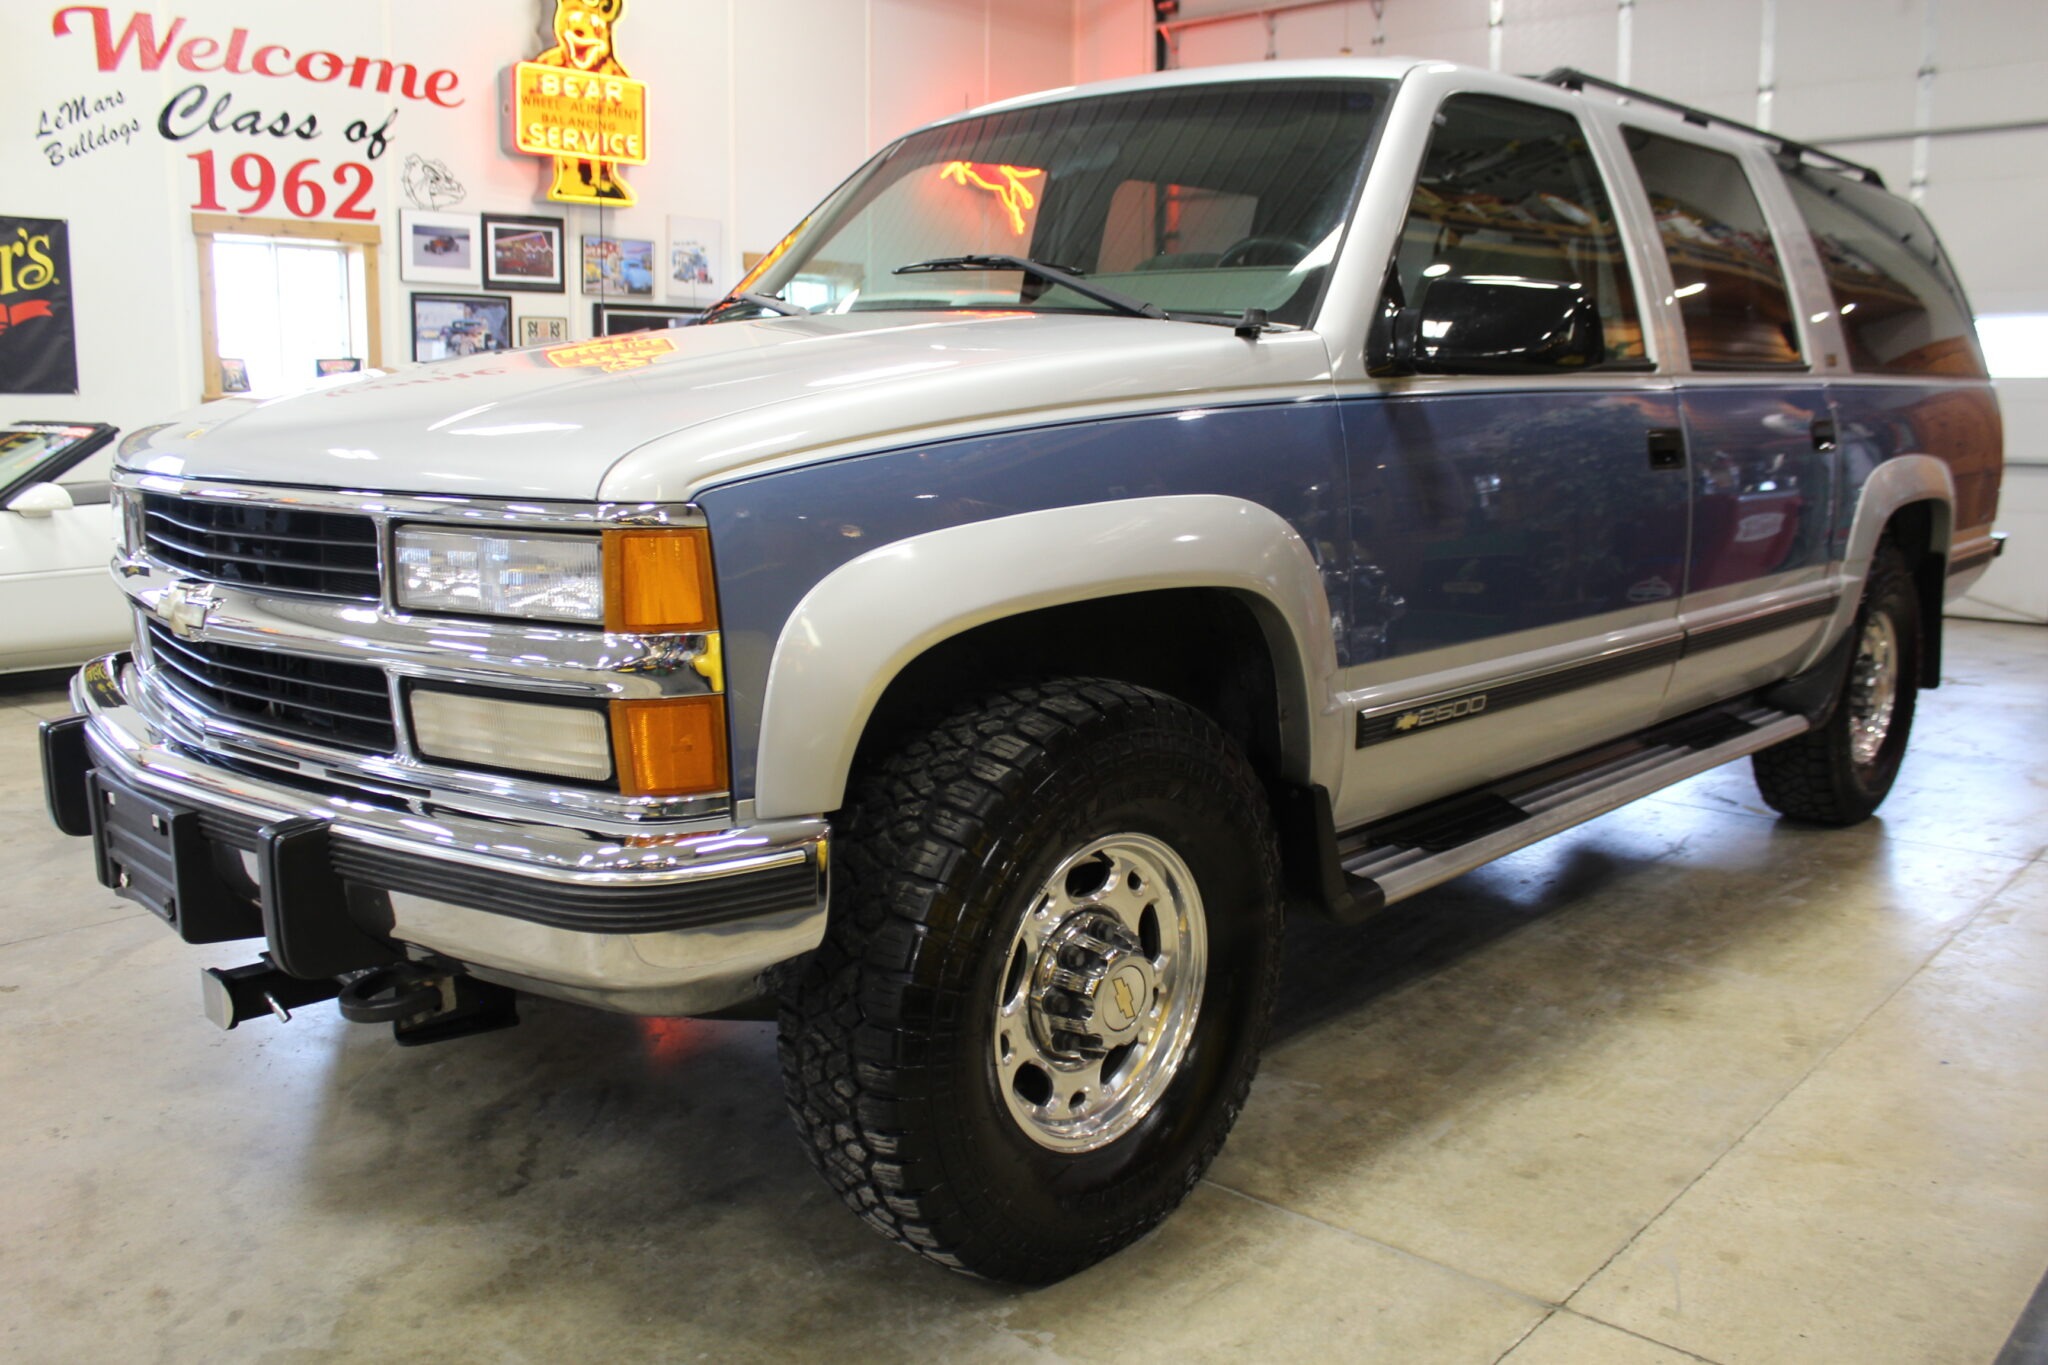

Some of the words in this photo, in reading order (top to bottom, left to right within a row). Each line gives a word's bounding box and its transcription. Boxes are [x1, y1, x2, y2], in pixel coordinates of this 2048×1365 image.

[52, 5, 465, 109] Welcome
[521, 95, 561, 110] WHEEL
[538, 74, 624, 103] BEAR
[35, 89, 126, 140] LeMars
[157, 84, 322, 142] Class
[344, 107, 398, 161] of
[541, 112, 618, 132] BALANCING
[43, 117, 141, 167] Bulldogs
[527, 122, 640, 156] SERVICE
[186, 149, 377, 222] 1962
[1418, 694, 1488, 727] 2500
